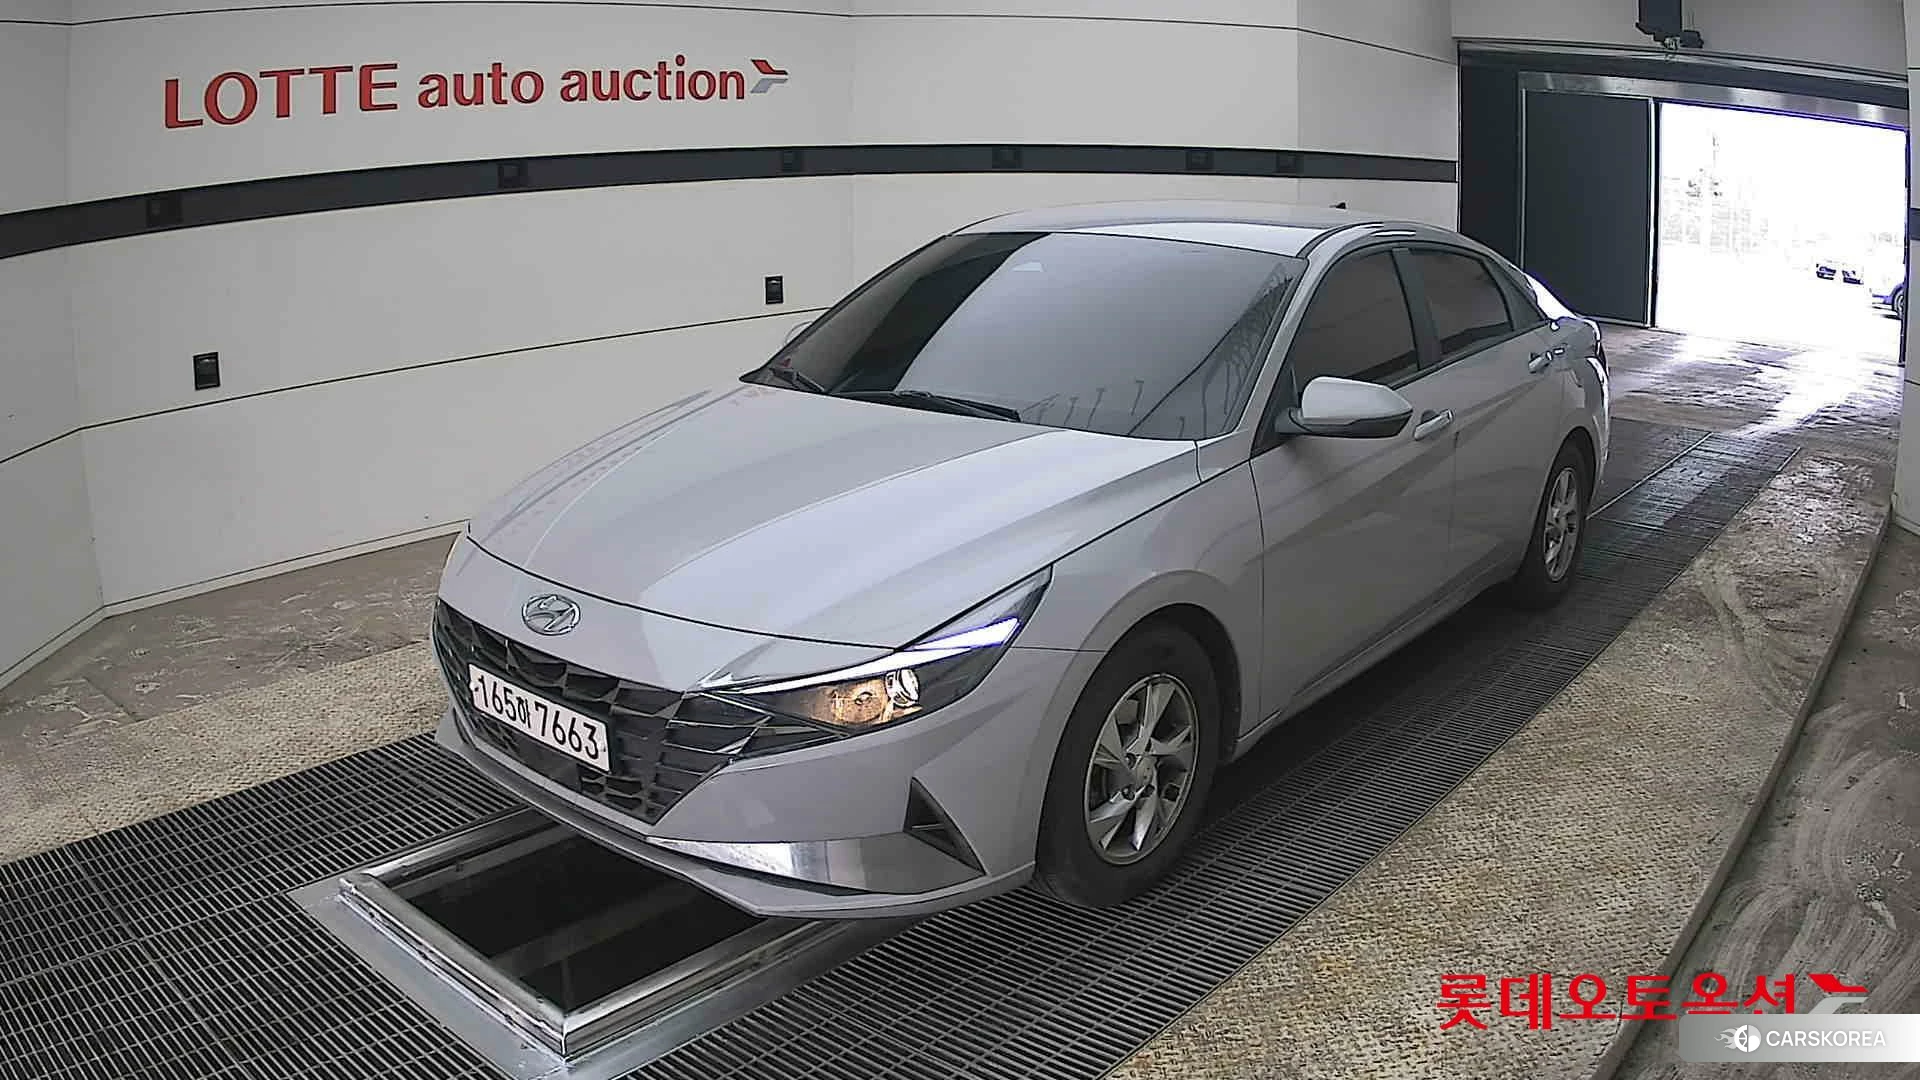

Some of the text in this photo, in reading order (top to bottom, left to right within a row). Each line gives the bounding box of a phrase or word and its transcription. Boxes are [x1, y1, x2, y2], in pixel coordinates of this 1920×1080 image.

[165, 54, 745, 129] LOTTE auto auction
